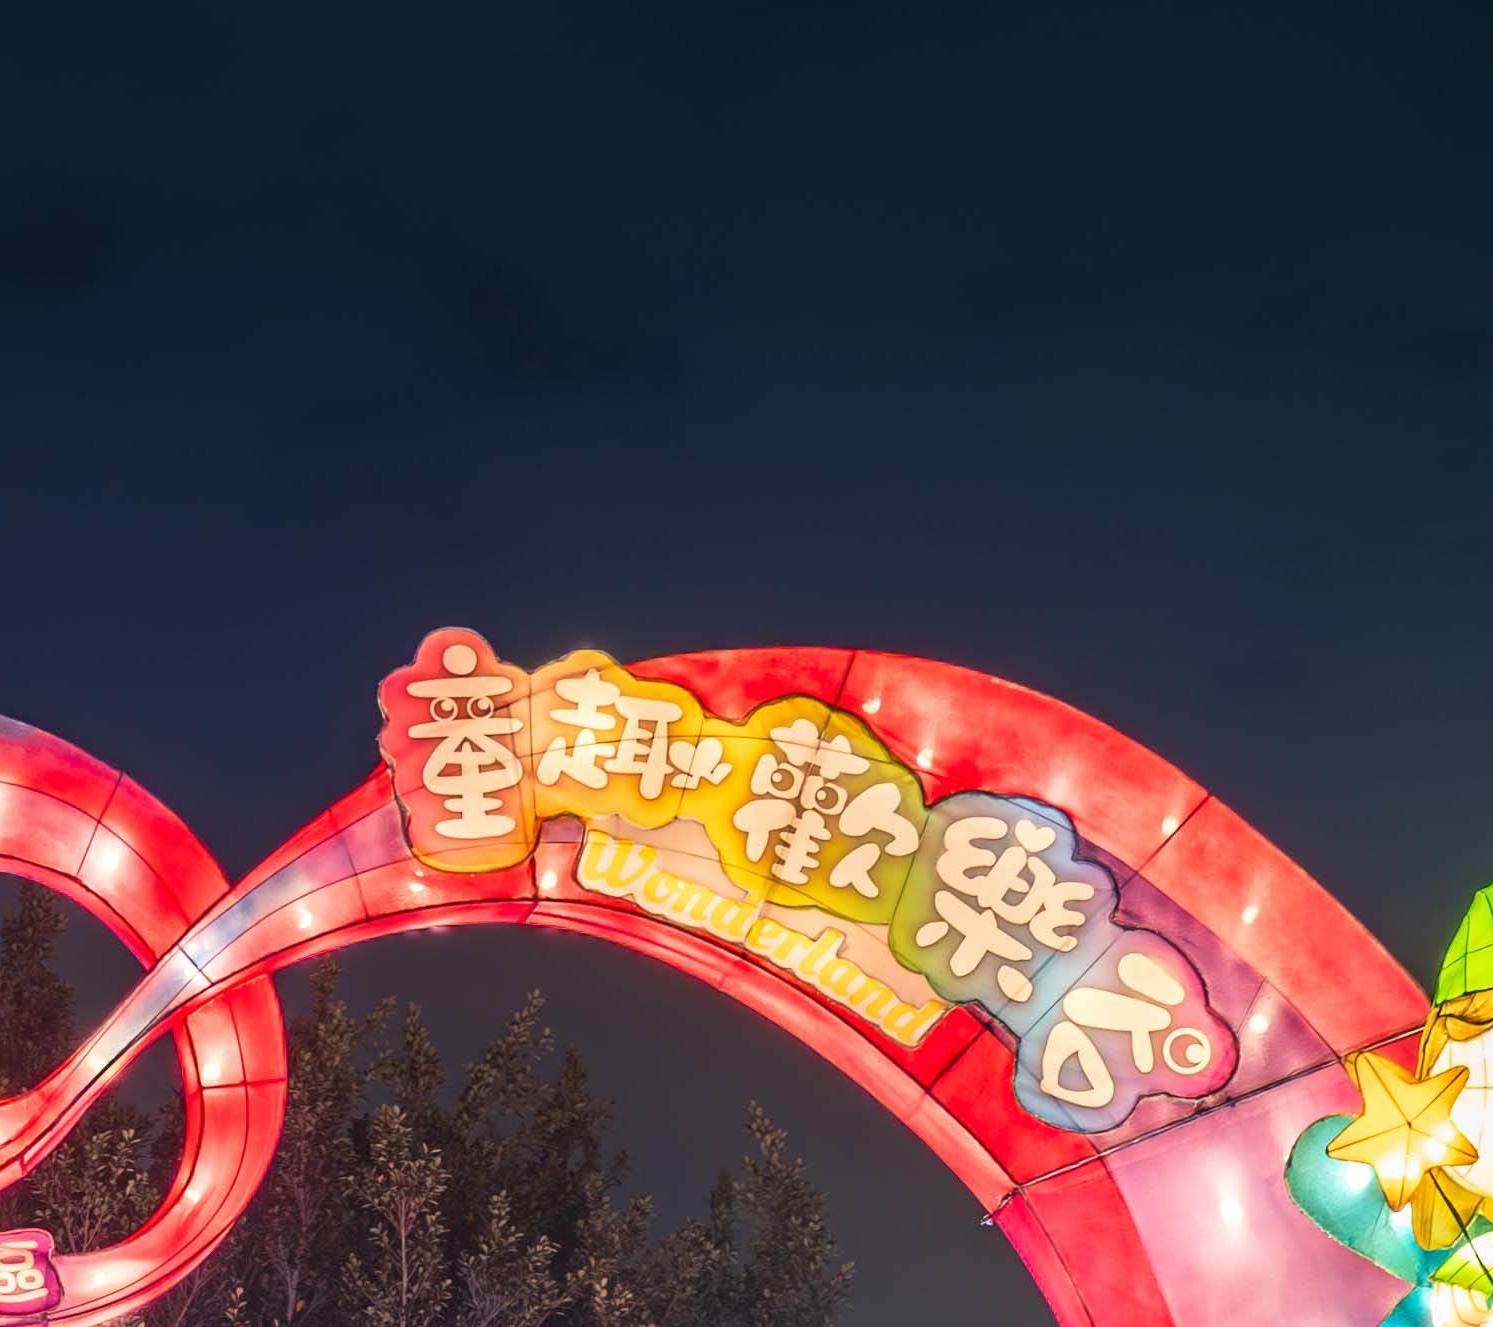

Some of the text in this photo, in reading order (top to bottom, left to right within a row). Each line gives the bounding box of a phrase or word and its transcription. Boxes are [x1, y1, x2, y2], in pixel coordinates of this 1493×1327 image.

[407, 645, 1211, 1109] 童趣歡樂谷
[582, 828, 948, 1044] Wonderland
